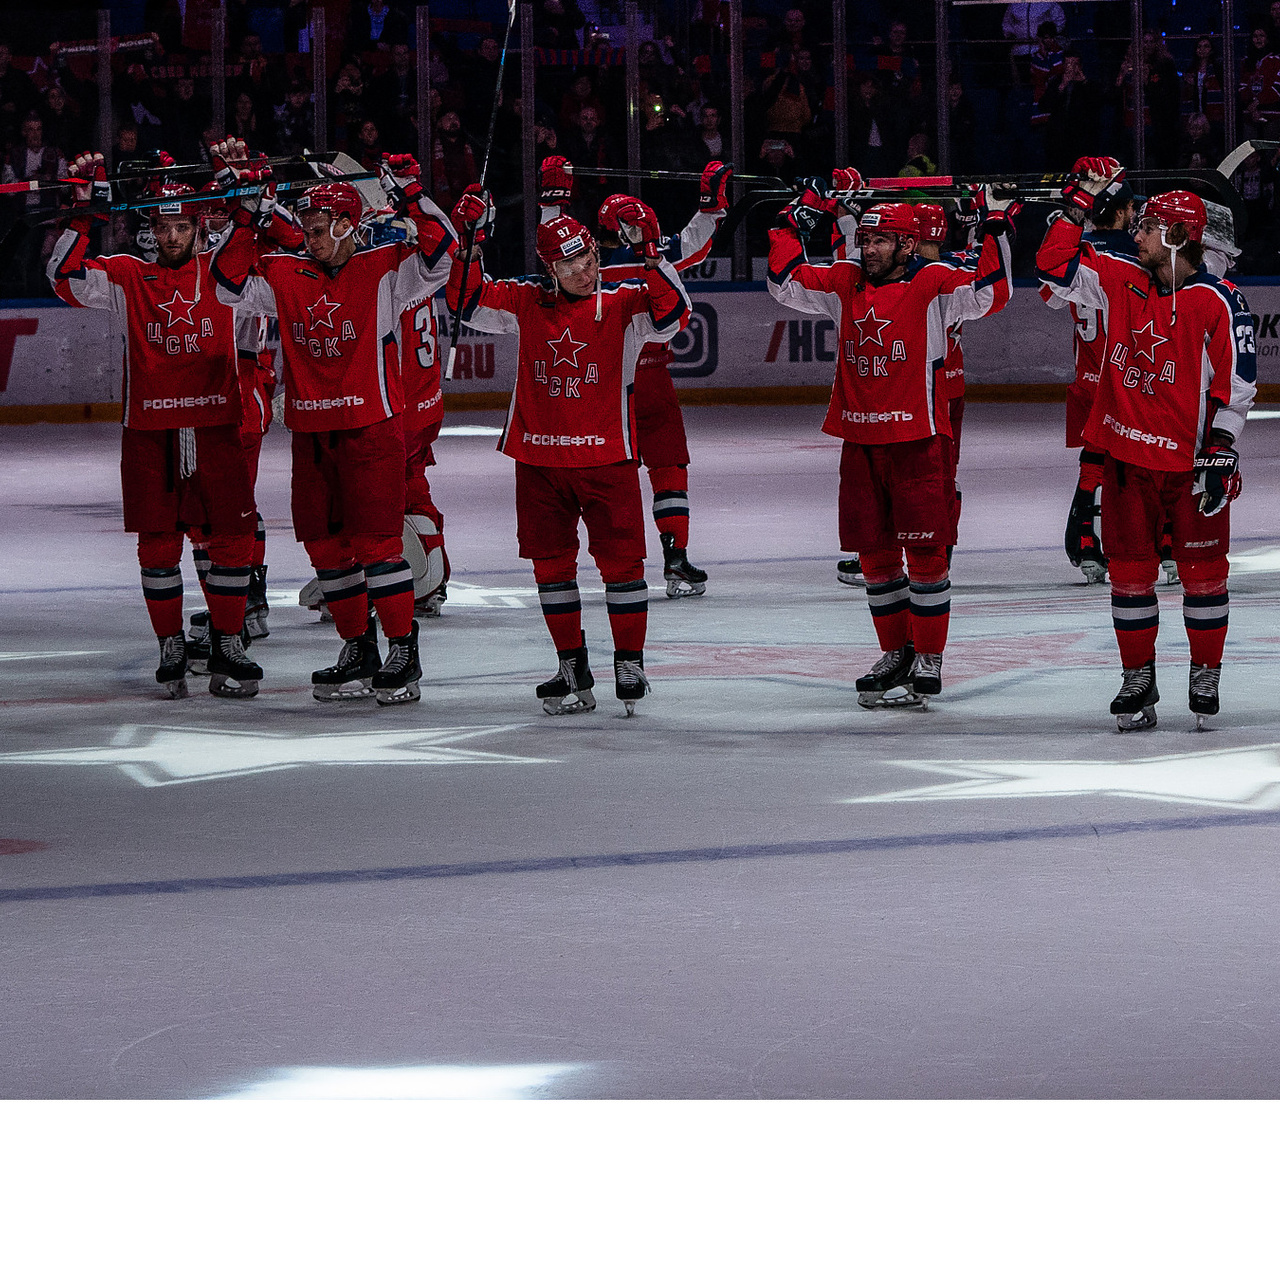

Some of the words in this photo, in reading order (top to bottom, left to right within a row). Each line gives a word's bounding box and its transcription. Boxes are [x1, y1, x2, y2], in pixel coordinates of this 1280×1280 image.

[556, 226, 571, 239] 97
[930, 226, 943, 237] 37
[147, 316, 214, 356] ЦСКА
[292, 319, 357, 358] ЦСКА
[1235, 324, 1257, 354] 23
[845, 339, 907, 377] ЦСКА
[1109, 342, 1176, 396] ЦСКА
[534, 360, 600, 399] ЦСКА
[143, 394, 227, 411] РОСНЕФТЬ
[841, 409, 914, 424] РОСНЕФТЬ
[522, 431, 606, 447] РОСНЕФТЬ
[1102, 413, 1179, 451] РОСНЕФТЬ
[897, 531, 935, 540] CCM
